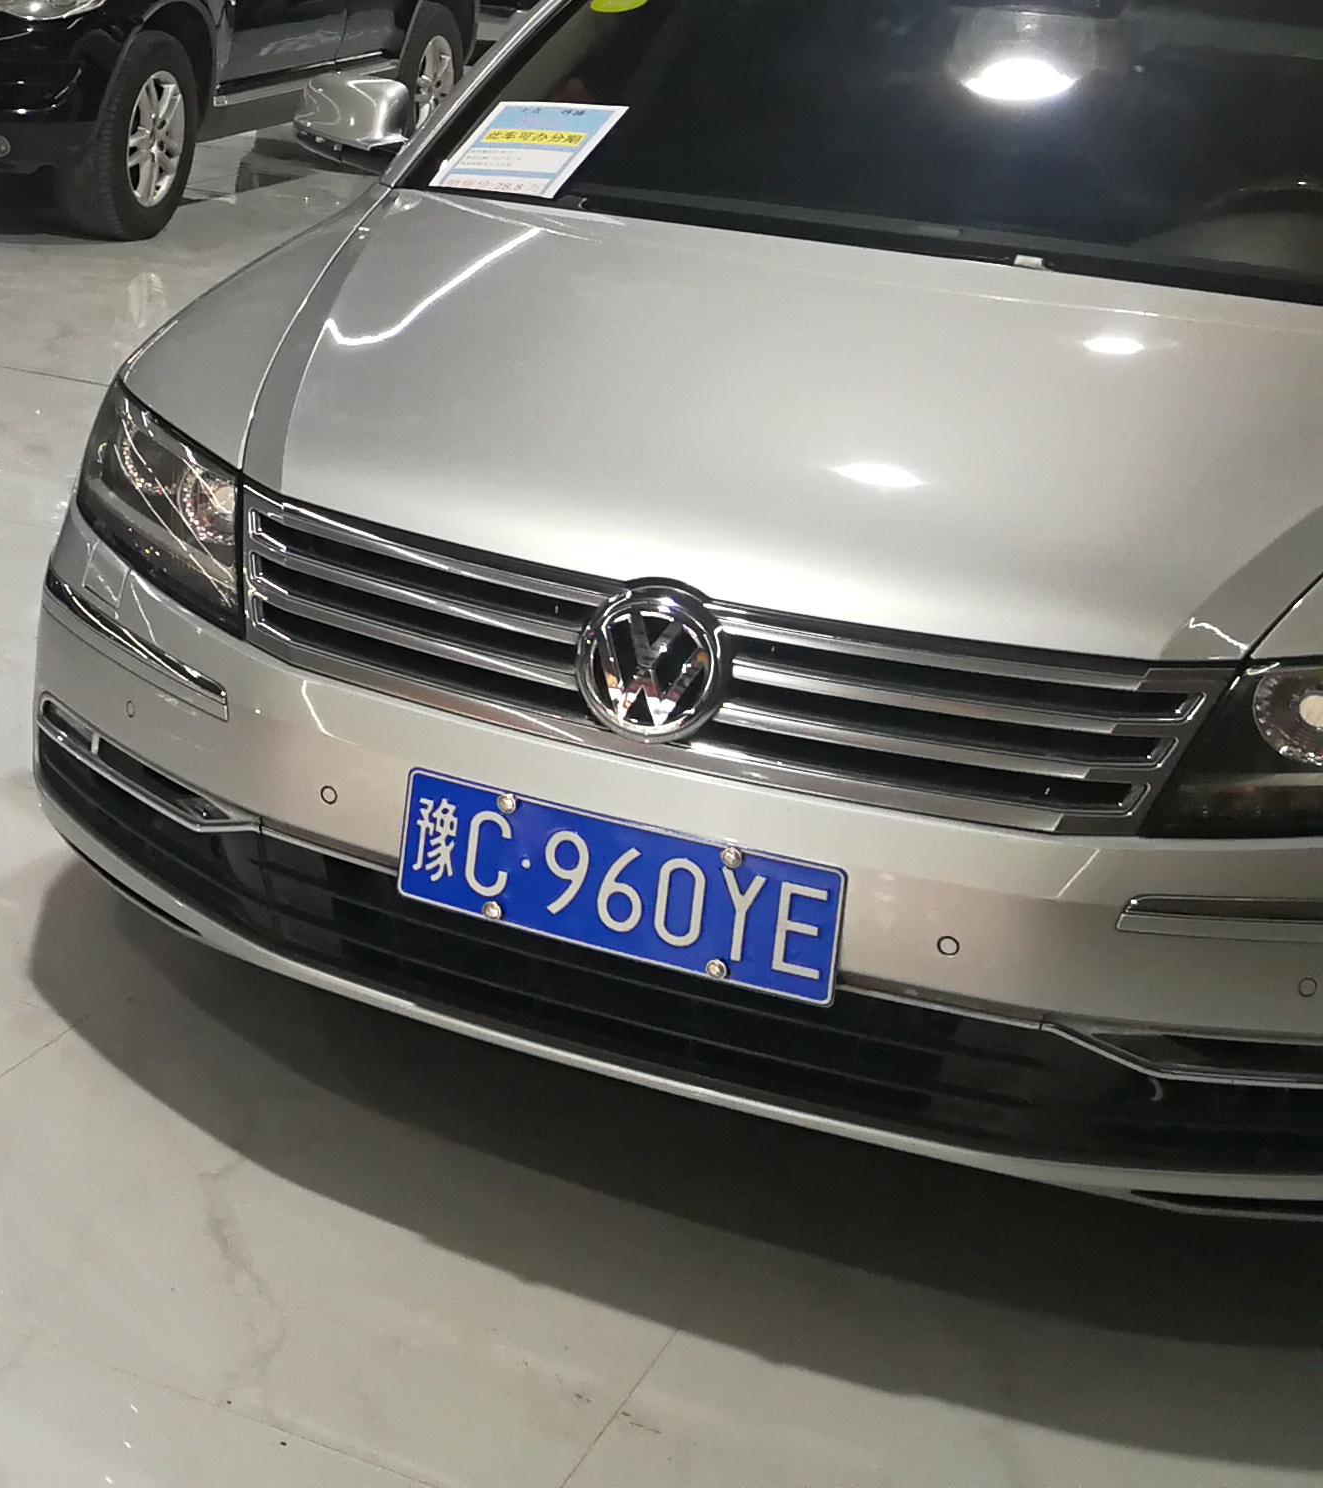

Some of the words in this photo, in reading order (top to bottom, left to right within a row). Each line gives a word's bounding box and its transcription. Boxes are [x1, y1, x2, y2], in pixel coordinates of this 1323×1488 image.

[485, 130, 583, 144] 此车可办分期
[412, 797, 829, 981] 豫C·960YE
